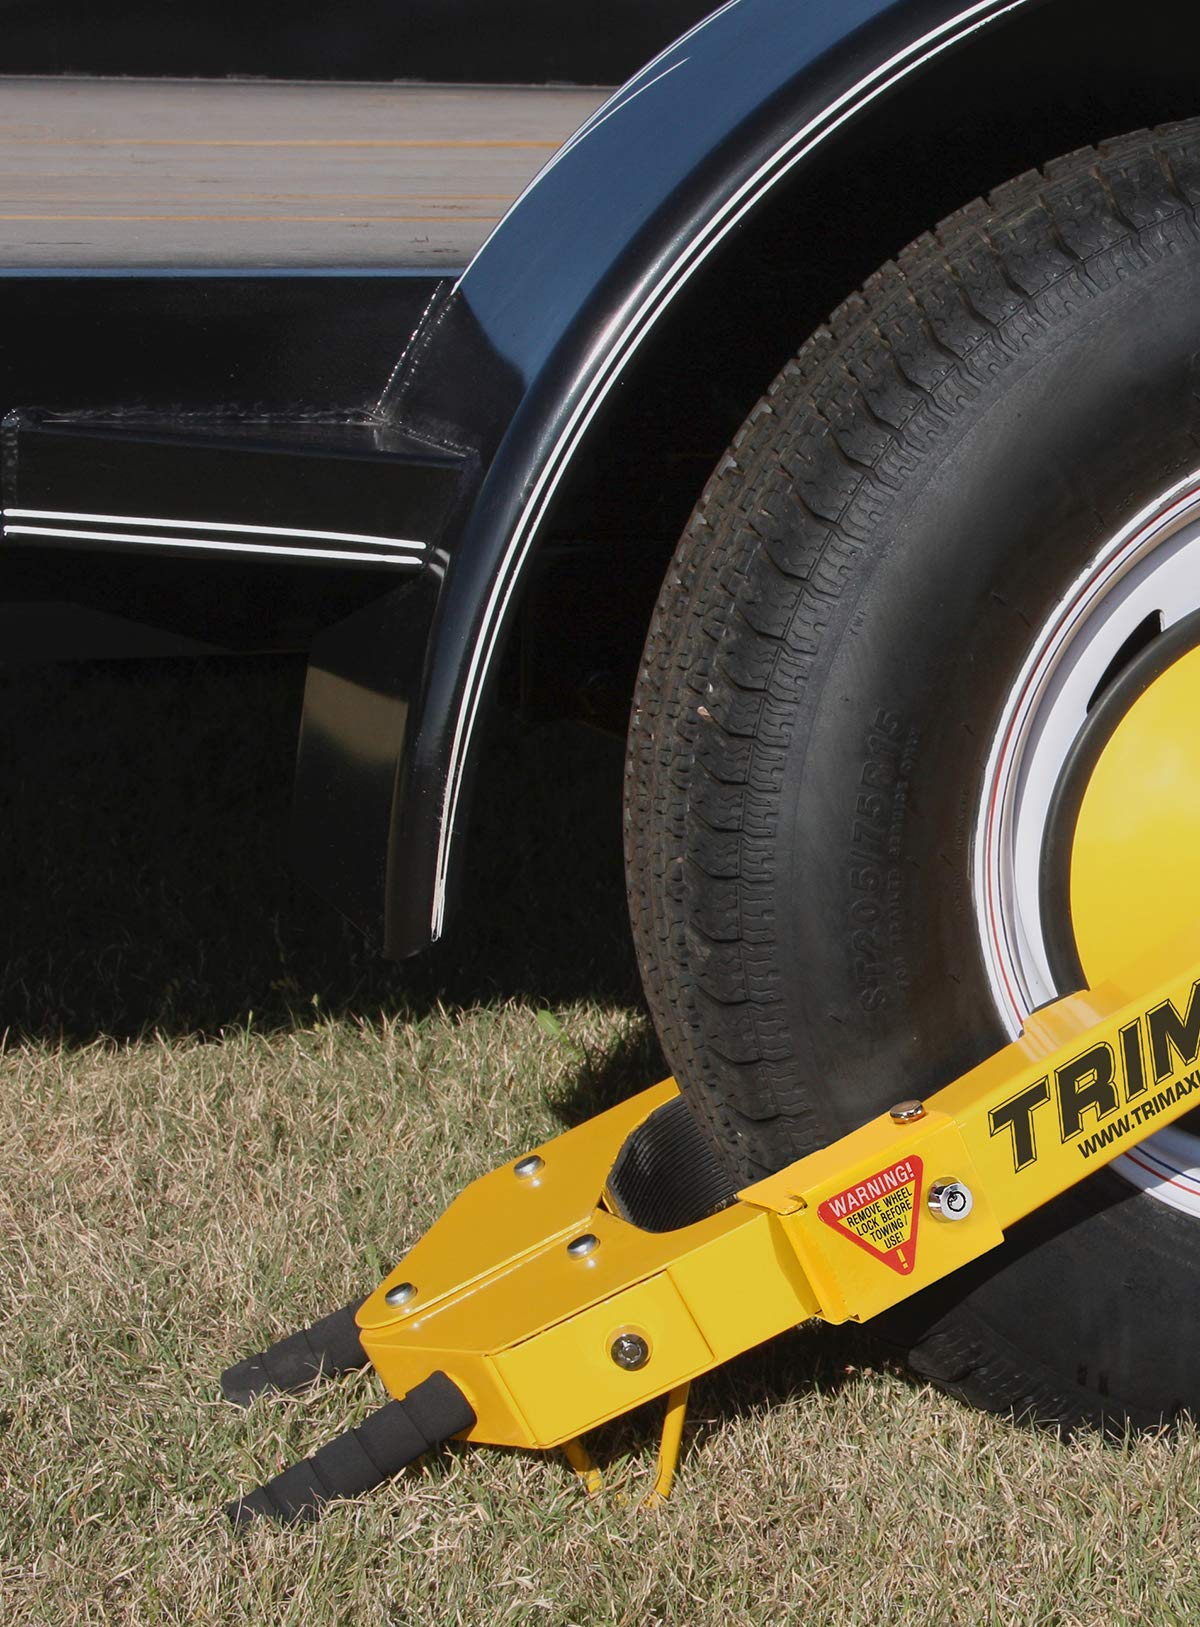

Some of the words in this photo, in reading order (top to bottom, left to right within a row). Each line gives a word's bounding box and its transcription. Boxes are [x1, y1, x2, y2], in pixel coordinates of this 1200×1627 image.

[828, 1161, 915, 1218] WARNING!
[846, 1201, 882, 1228] REMOVE
[882, 1186, 913, 1207] WHEEL
[856, 1217, 879, 1236] LOCK
[881, 1199, 913, 1223] BEFORE
[884, 1233, 905, 1249] USE!
